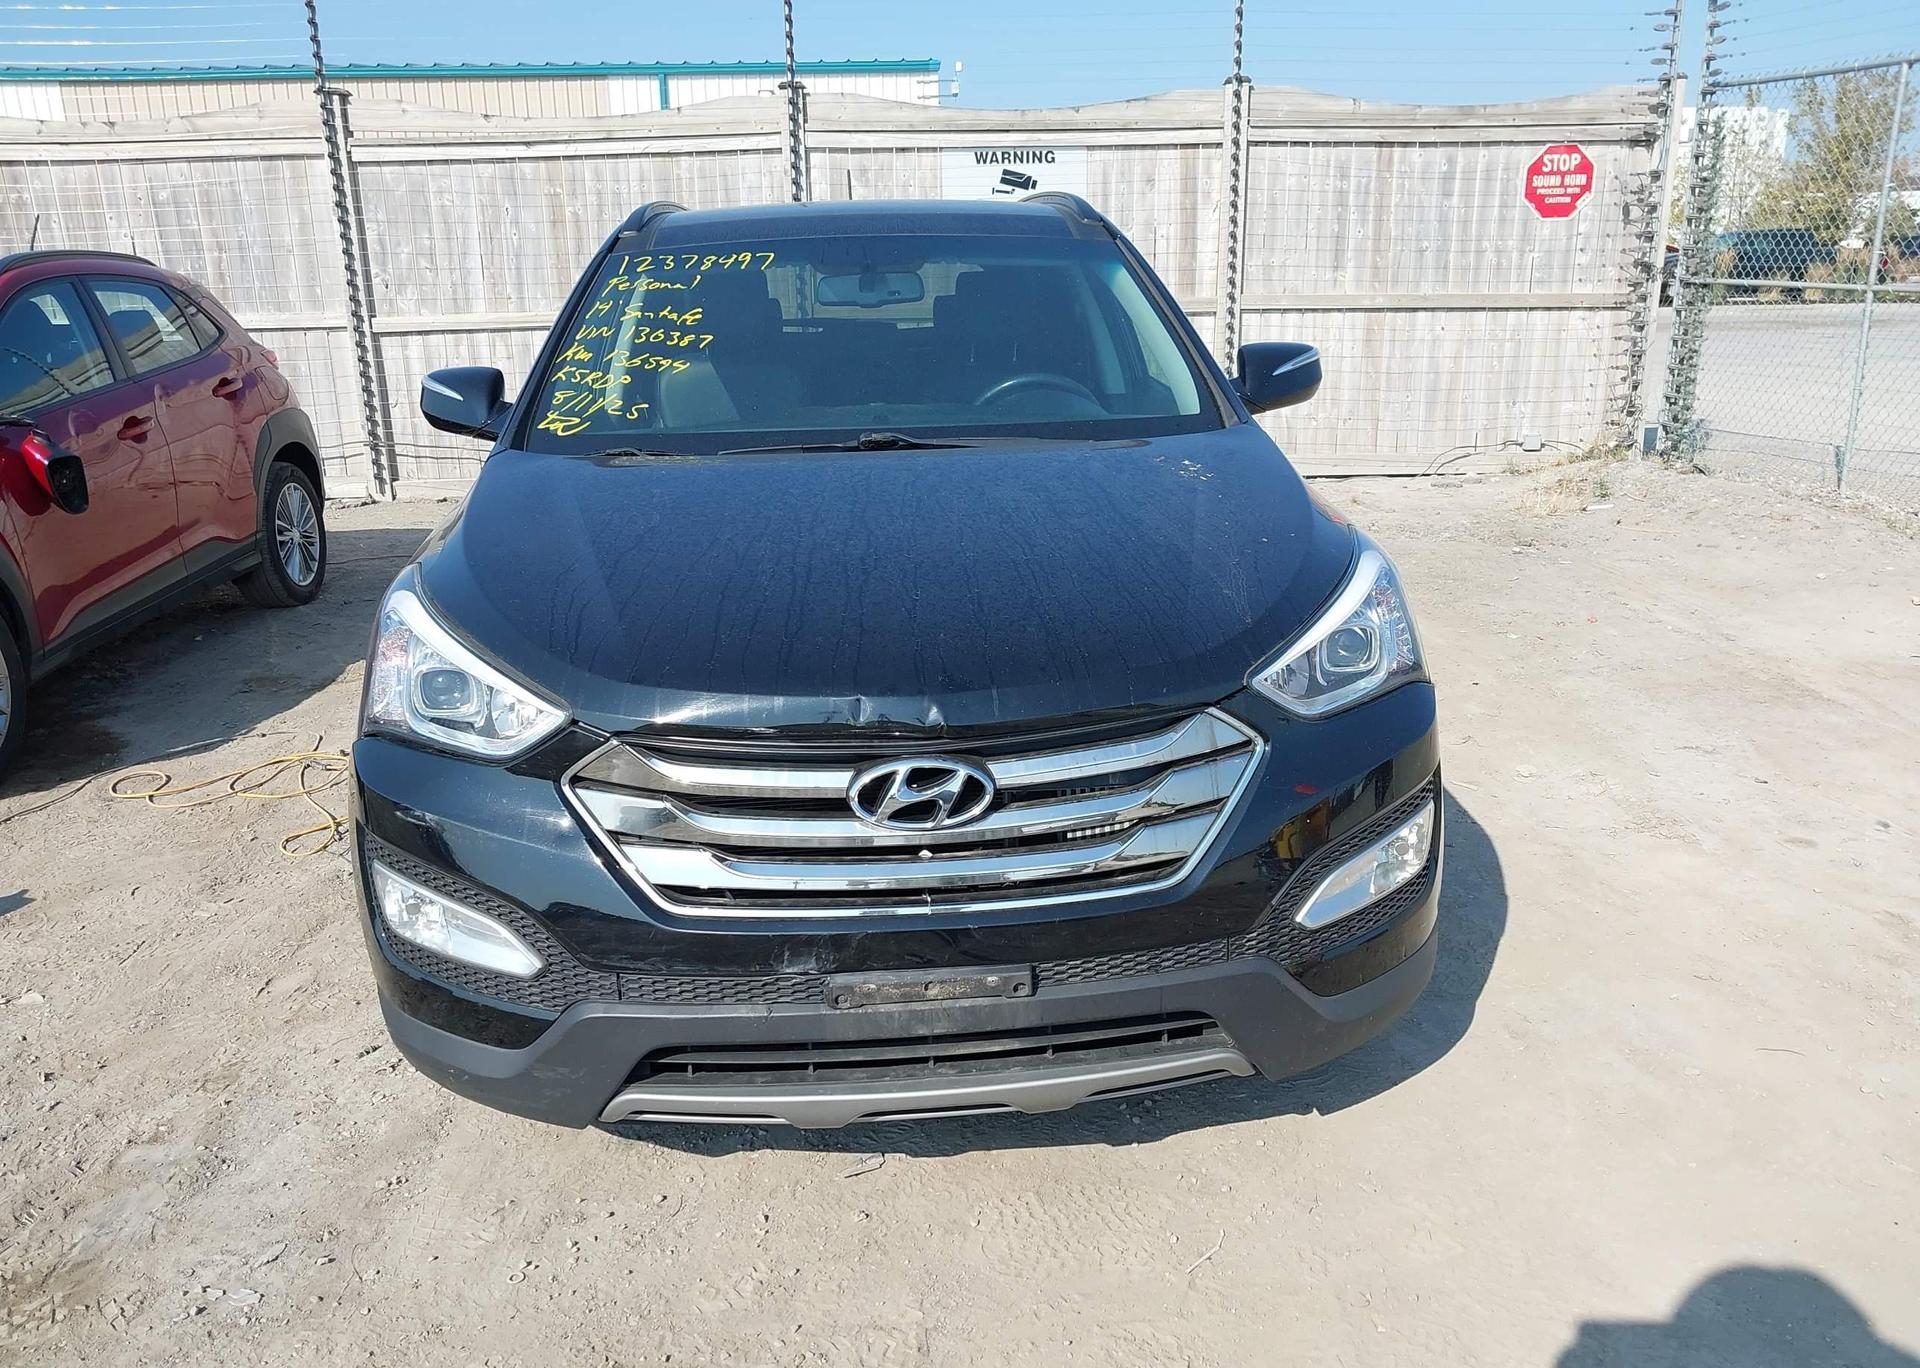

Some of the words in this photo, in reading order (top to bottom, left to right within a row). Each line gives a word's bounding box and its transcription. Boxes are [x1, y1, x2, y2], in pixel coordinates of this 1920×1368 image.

[974, 150, 1056, 165] WARNING
[1542, 153, 1581, 172] STOP
[1532, 174, 1562, 187] SOUND
[1564, 174, 1587, 186] HORN
[618, 252, 776, 275] 12378497
[623, 326, 715, 350] 136387
[603, 349, 691, 374] 136594
